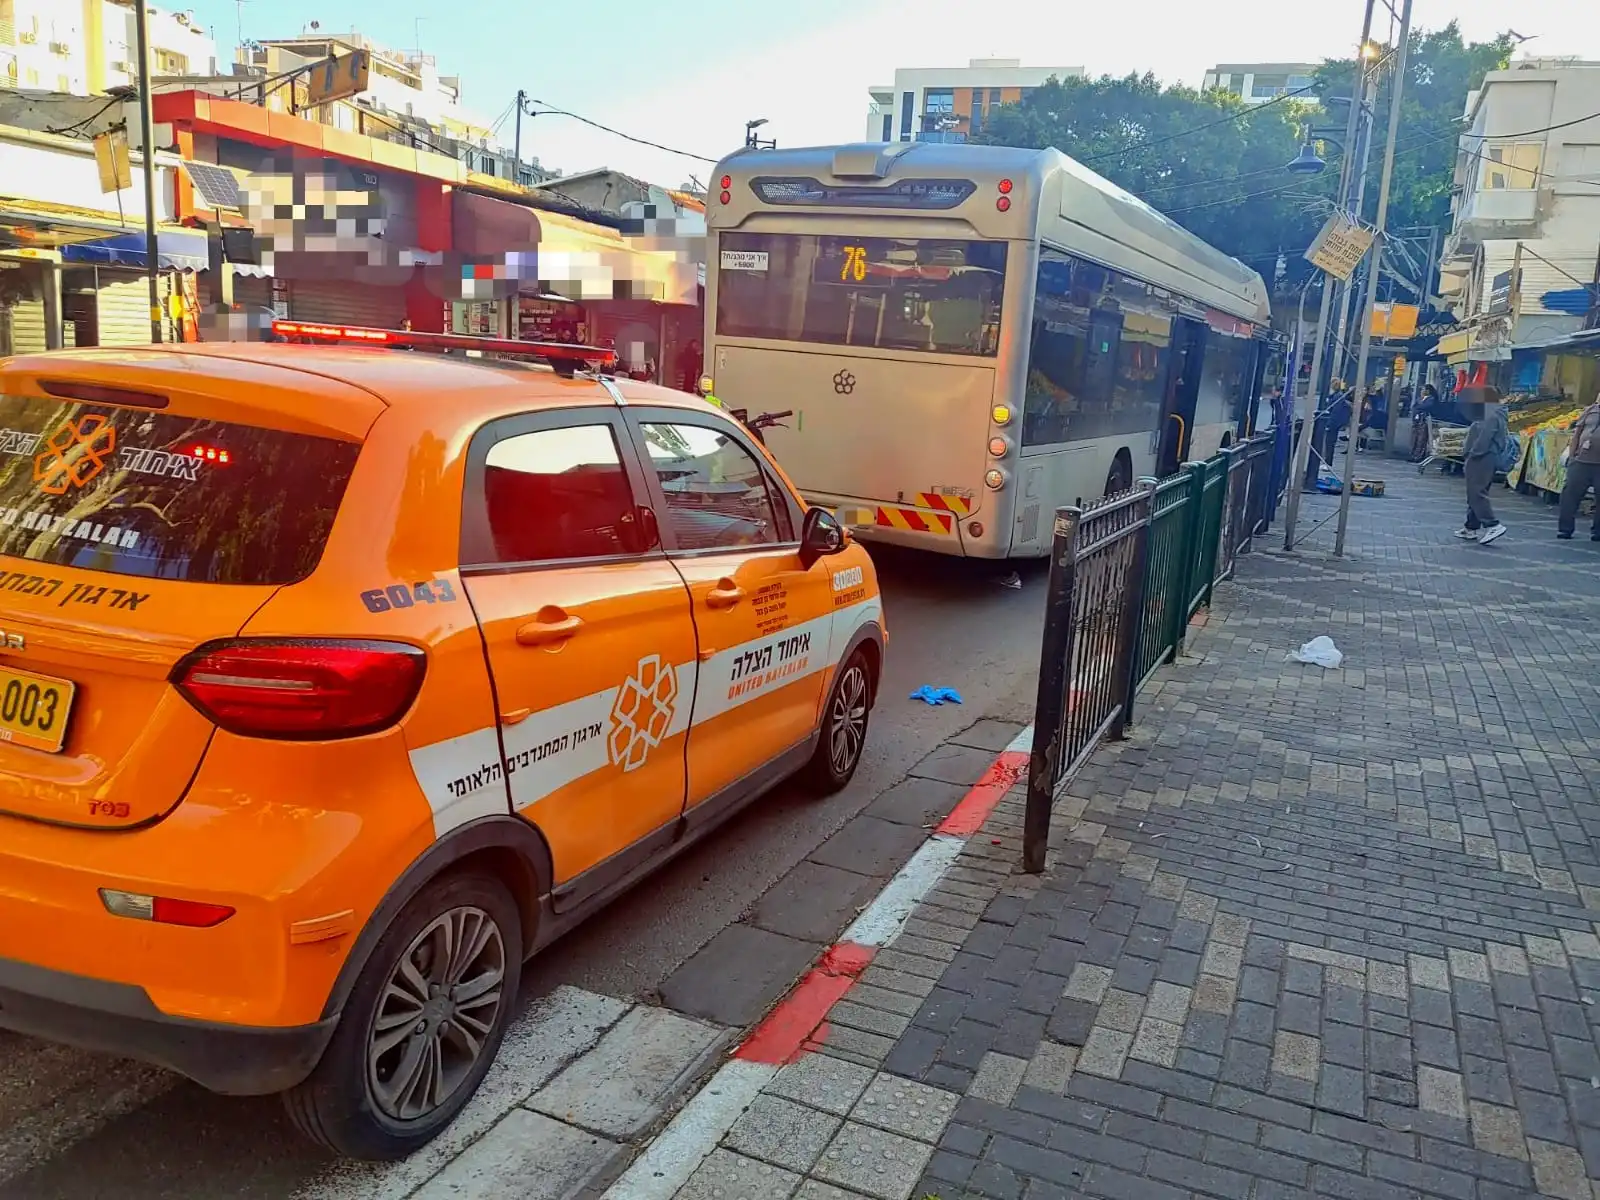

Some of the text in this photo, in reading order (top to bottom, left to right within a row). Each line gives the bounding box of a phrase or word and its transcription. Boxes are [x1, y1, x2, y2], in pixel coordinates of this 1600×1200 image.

[841, 246, 866, 281] 76
[120, 446, 202, 481] איחוד
[20, 510, 140, 549] HATZALAH
[58, 583, 150, 611] ארגון
[360, 578, 457, 613] 6043
[731, 632, 811, 681] איחוד הצלה
[728, 674, 764, 700] UNITED
[447, 722, 603, 797] ארגון המתנדבים הלאומי
